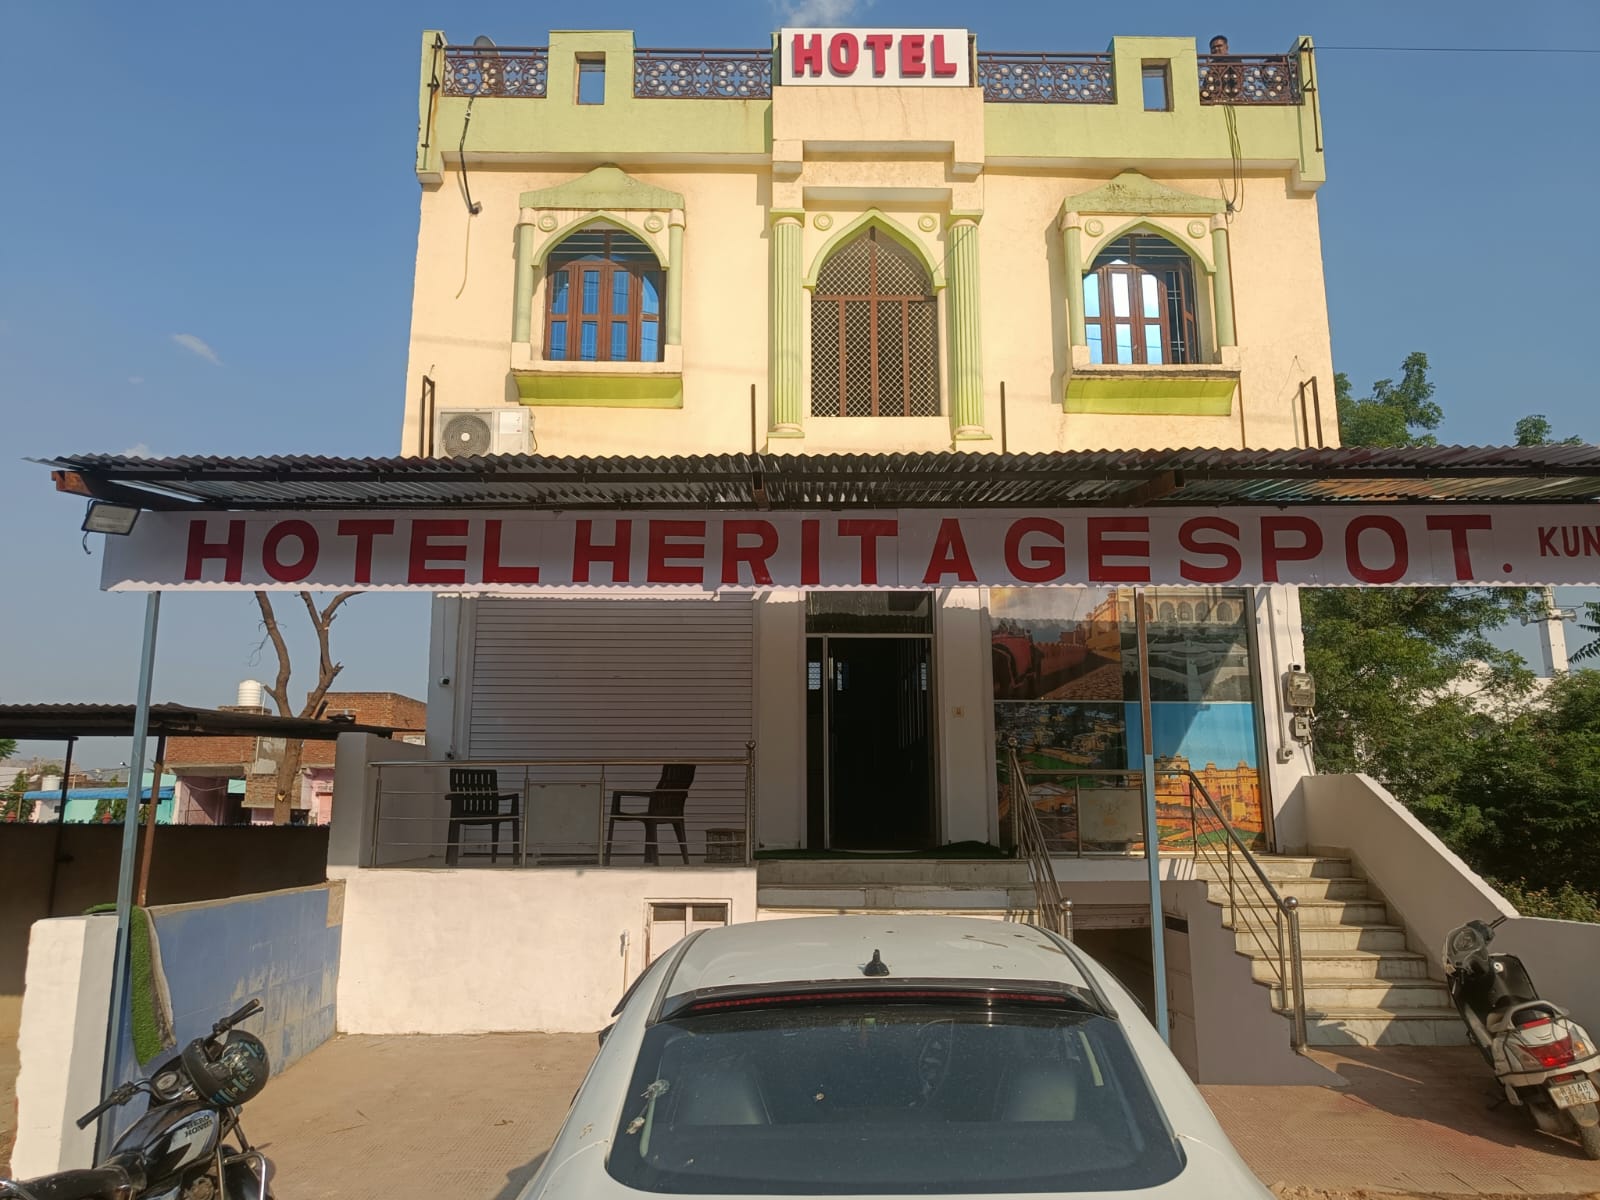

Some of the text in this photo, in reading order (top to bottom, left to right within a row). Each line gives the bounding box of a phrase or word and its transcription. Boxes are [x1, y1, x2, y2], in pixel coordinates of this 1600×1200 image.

[792, 32, 958, 77] HOTEL
[184, 519, 540, 584] HOTEL
[1537, 526, 1600, 557] KUN
